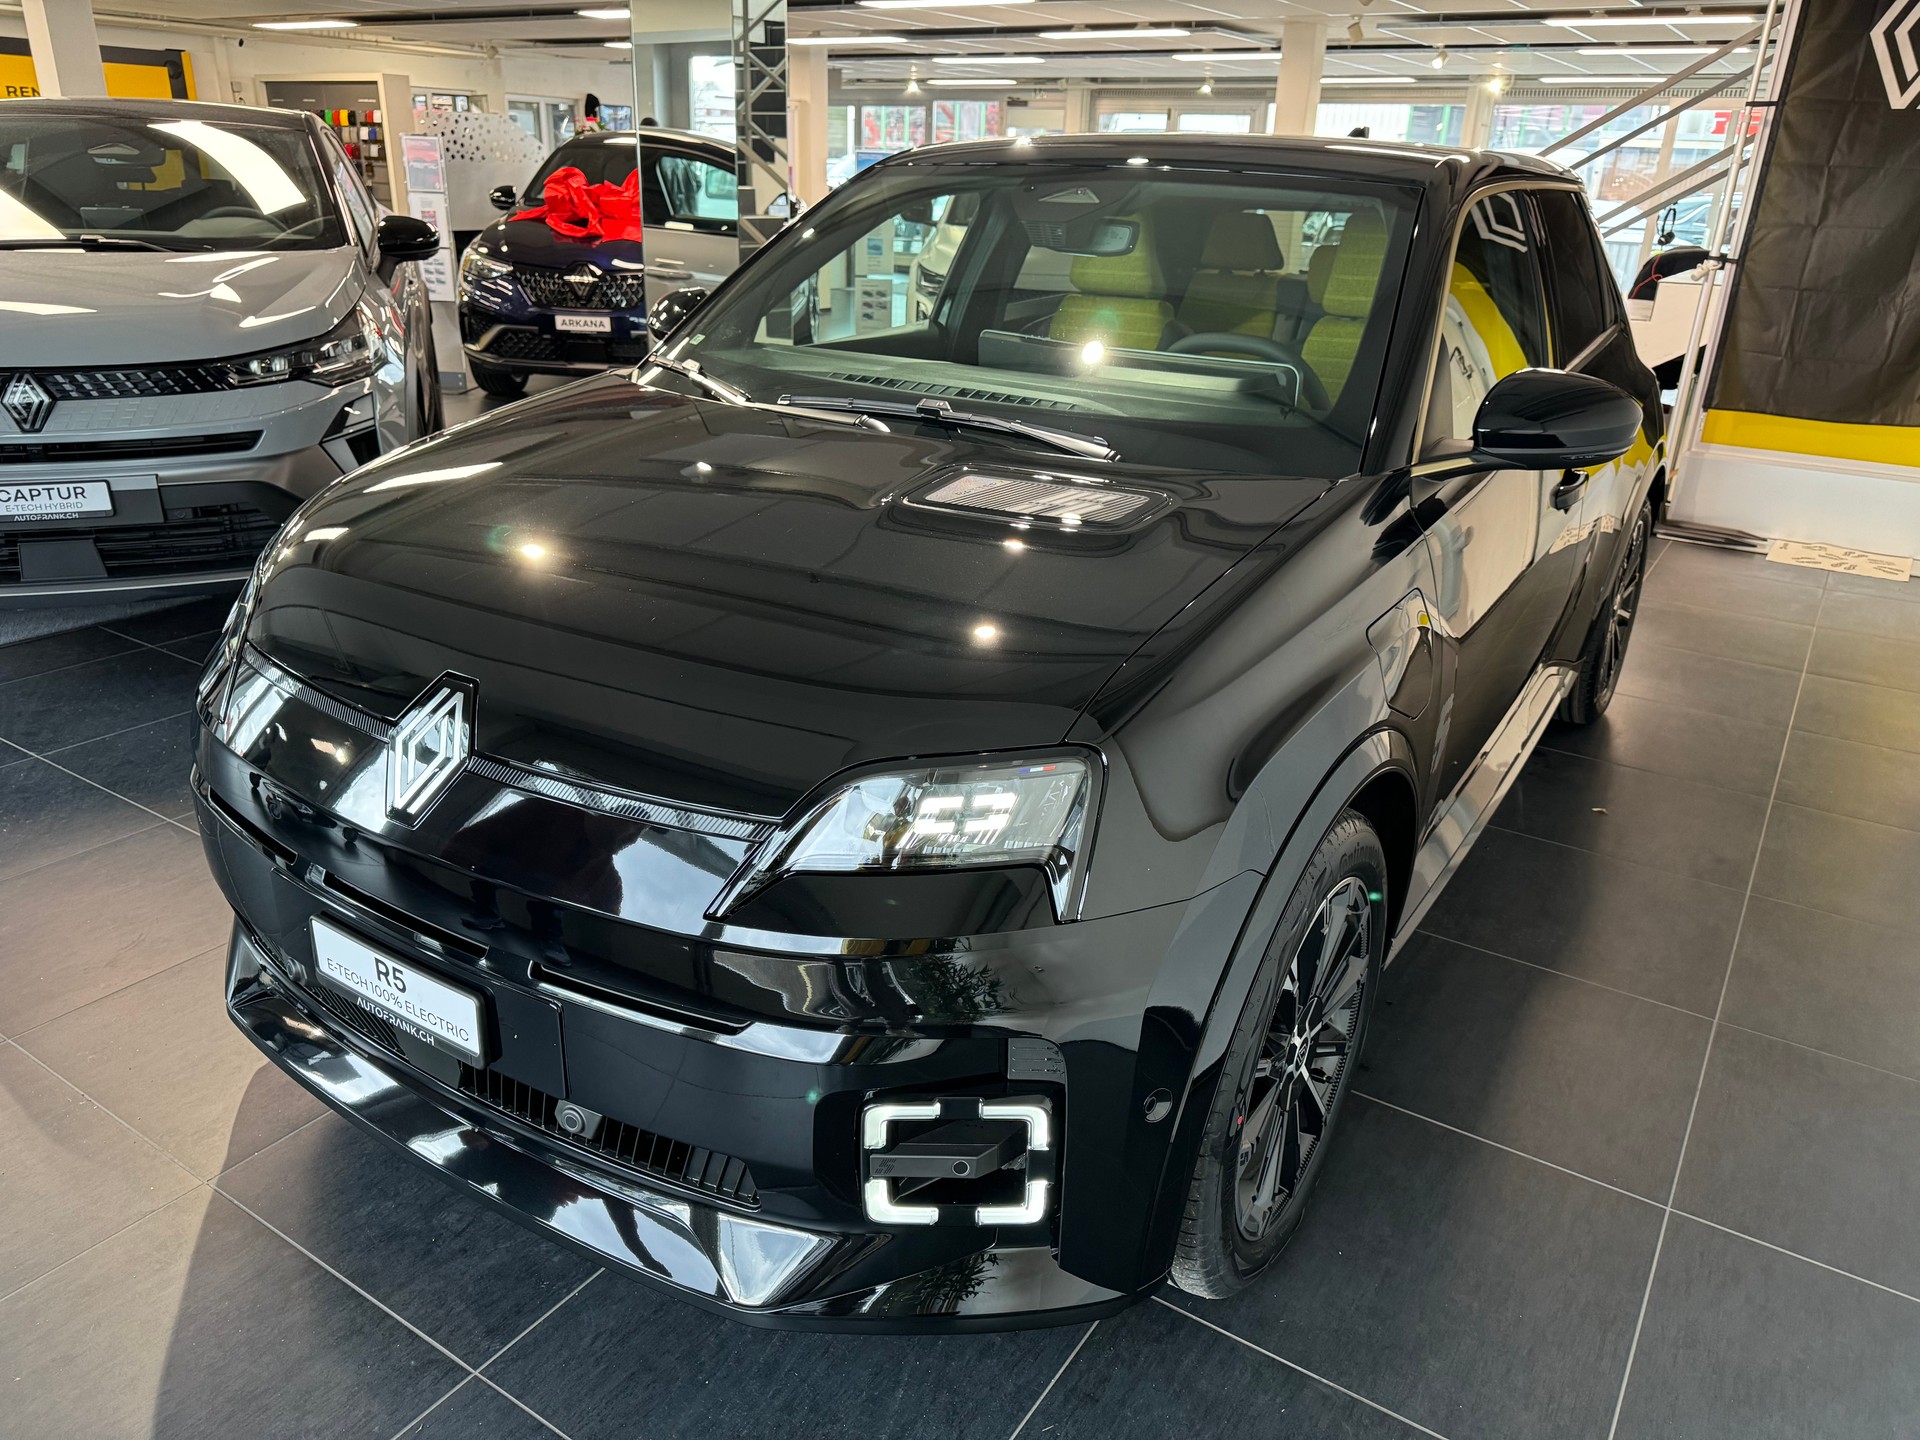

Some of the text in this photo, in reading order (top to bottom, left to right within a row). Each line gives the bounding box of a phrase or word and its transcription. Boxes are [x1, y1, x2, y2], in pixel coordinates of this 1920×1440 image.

[561, 319, 606, 328] ARKANA
[0, 486, 87, 503] CAPTUR
[5, 501, 83, 512] E-TECH HYBRID
[14, 512, 79, 522] AUTOFRANK.CH
[374, 957, 407, 993] R5
[327, 957, 469, 1042] E-TECH 100% ELECTRIC
[356, 997, 435, 1046] AUTOFRANK.CH
